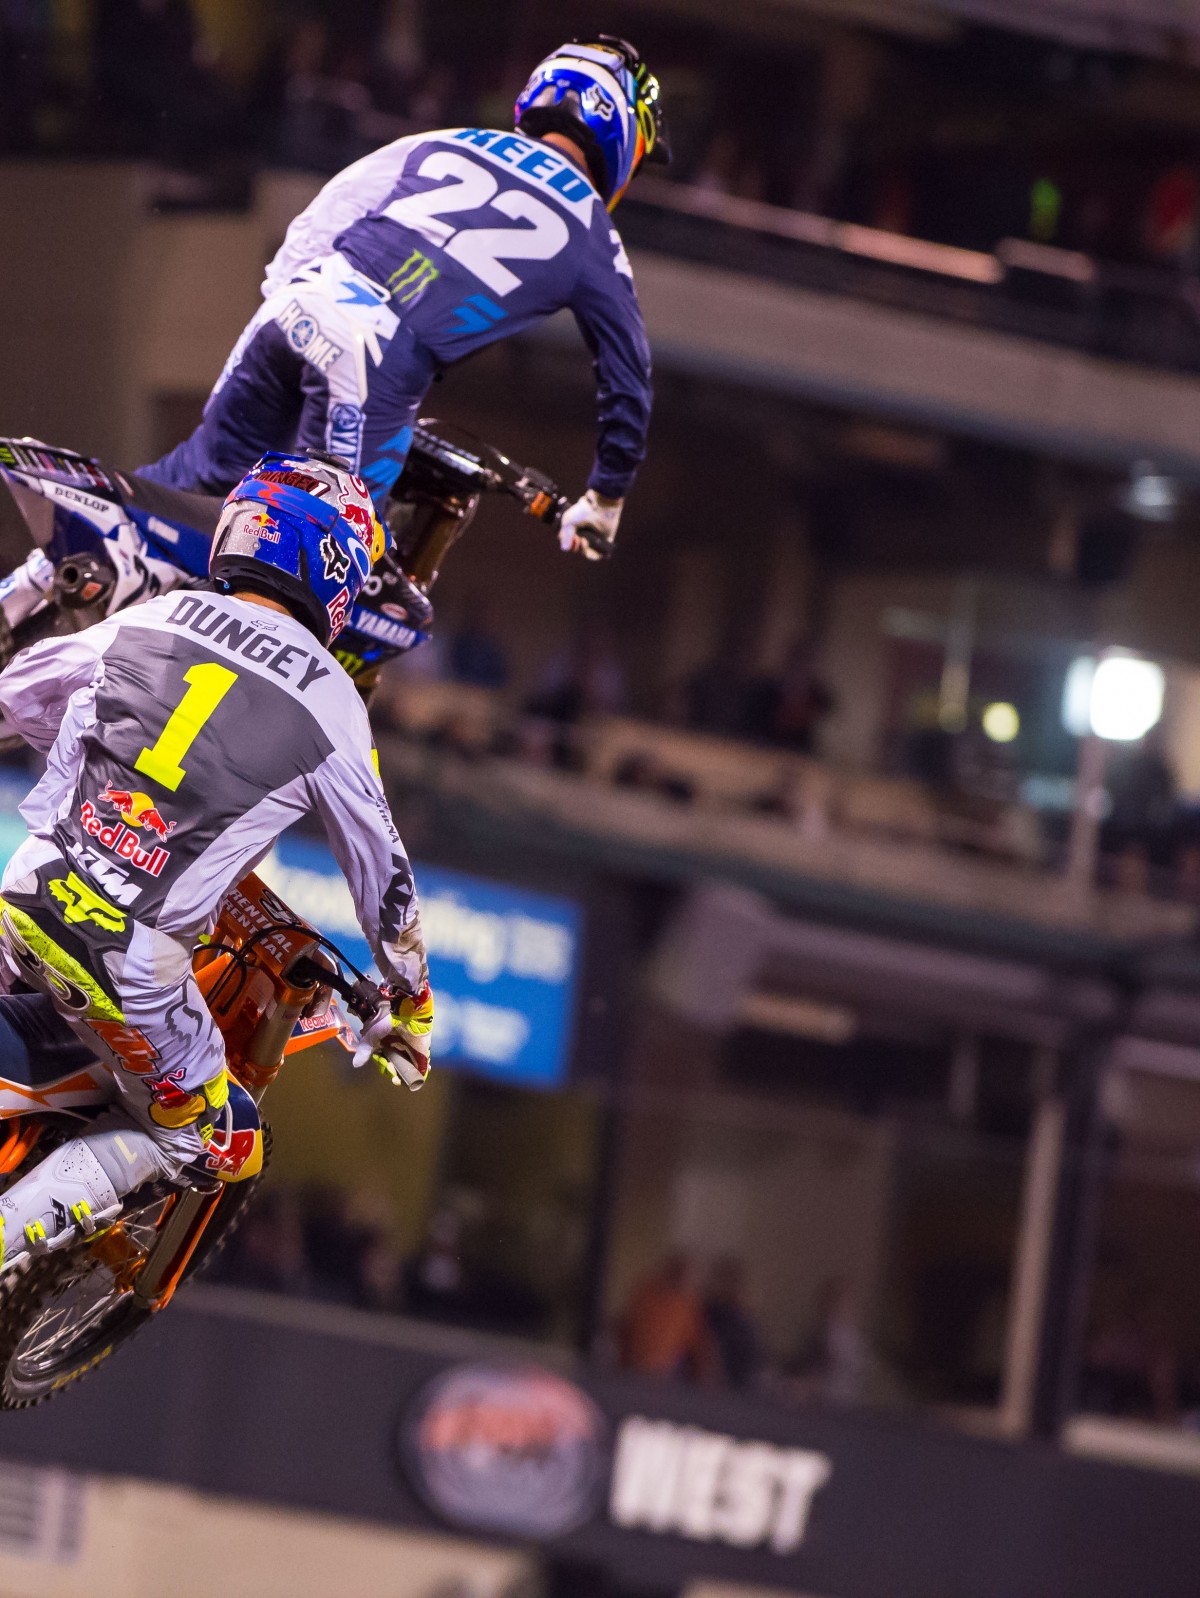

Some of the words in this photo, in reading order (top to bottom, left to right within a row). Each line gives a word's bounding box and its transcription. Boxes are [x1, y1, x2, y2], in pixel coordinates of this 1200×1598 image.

[453, 128, 593, 203] REED
[380, 150, 571, 298] 22
[54, 486, 110, 513] DUNLOP
[243, 524, 263, 538] Red
[259, 528, 282, 544] Bull
[166, 596, 331, 692] DUNGEY
[355, 609, 417, 650] YAMAHA
[133, 663, 239, 793] 1
[80, 799, 126, 850] Red
[114, 828, 171, 878] Bull
